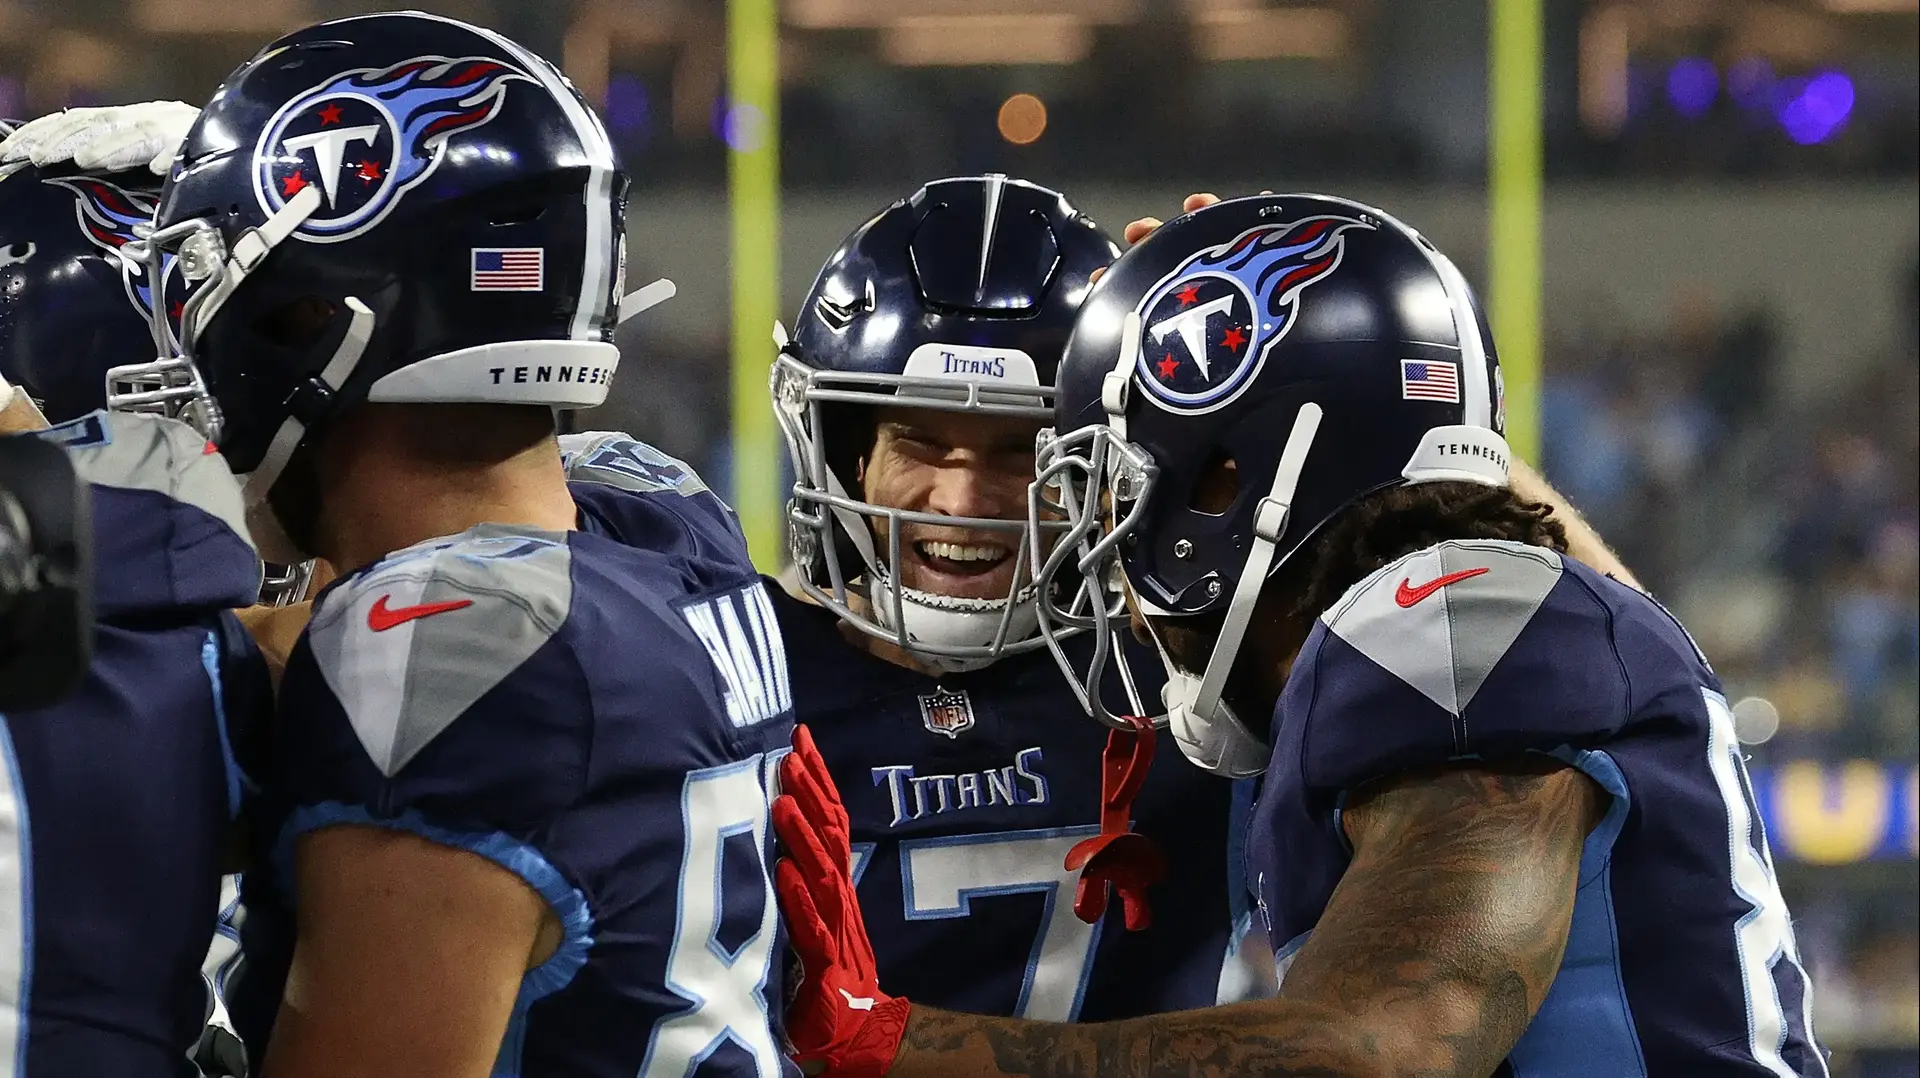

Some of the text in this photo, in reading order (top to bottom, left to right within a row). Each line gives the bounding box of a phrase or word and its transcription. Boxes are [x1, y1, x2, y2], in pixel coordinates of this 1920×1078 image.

[489, 365, 614, 387] TENNESS
[939, 350, 1006, 378] TITANS
[931, 706, 968, 728] NFL
[871, 746, 1050, 828] TITANS
[636, 746, 794, 1078] 8
[848, 820, 1136, 1023] 7
